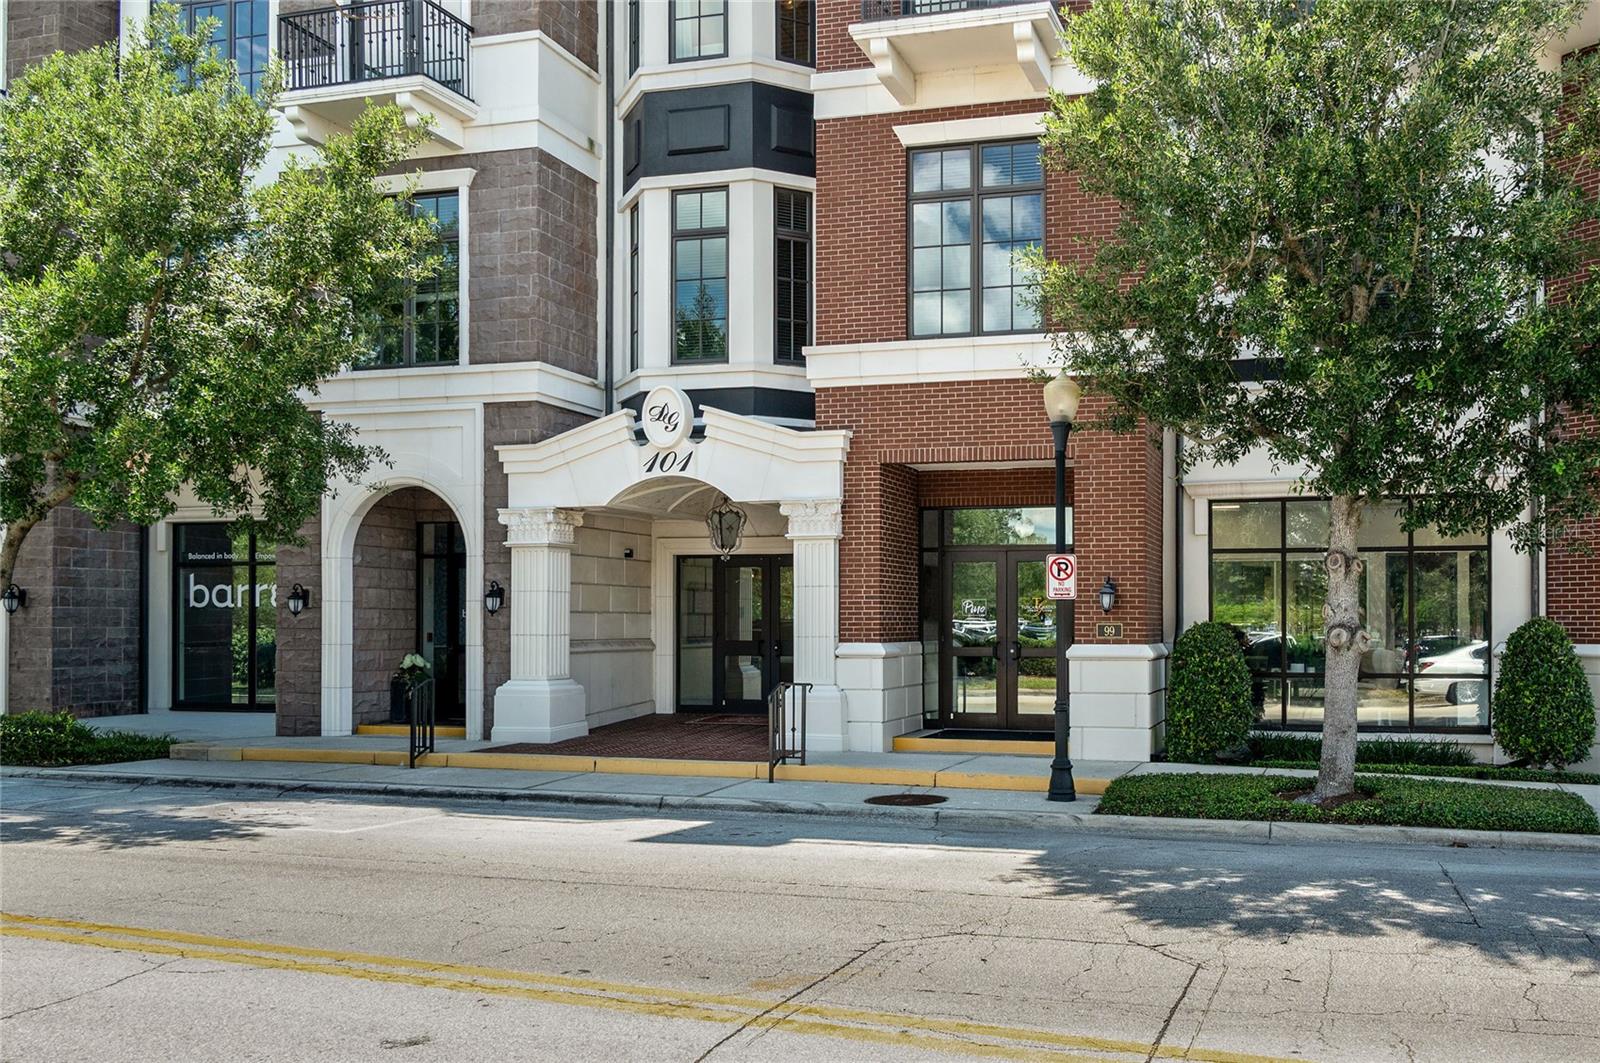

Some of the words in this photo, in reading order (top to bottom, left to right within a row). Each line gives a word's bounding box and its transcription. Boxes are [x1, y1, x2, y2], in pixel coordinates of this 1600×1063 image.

[643, 451, 693, 473] 101
[188, 552, 216, 561] Balanced
[216, 552, 223, 560] in
[1104, 626, 1115, 637] 99
